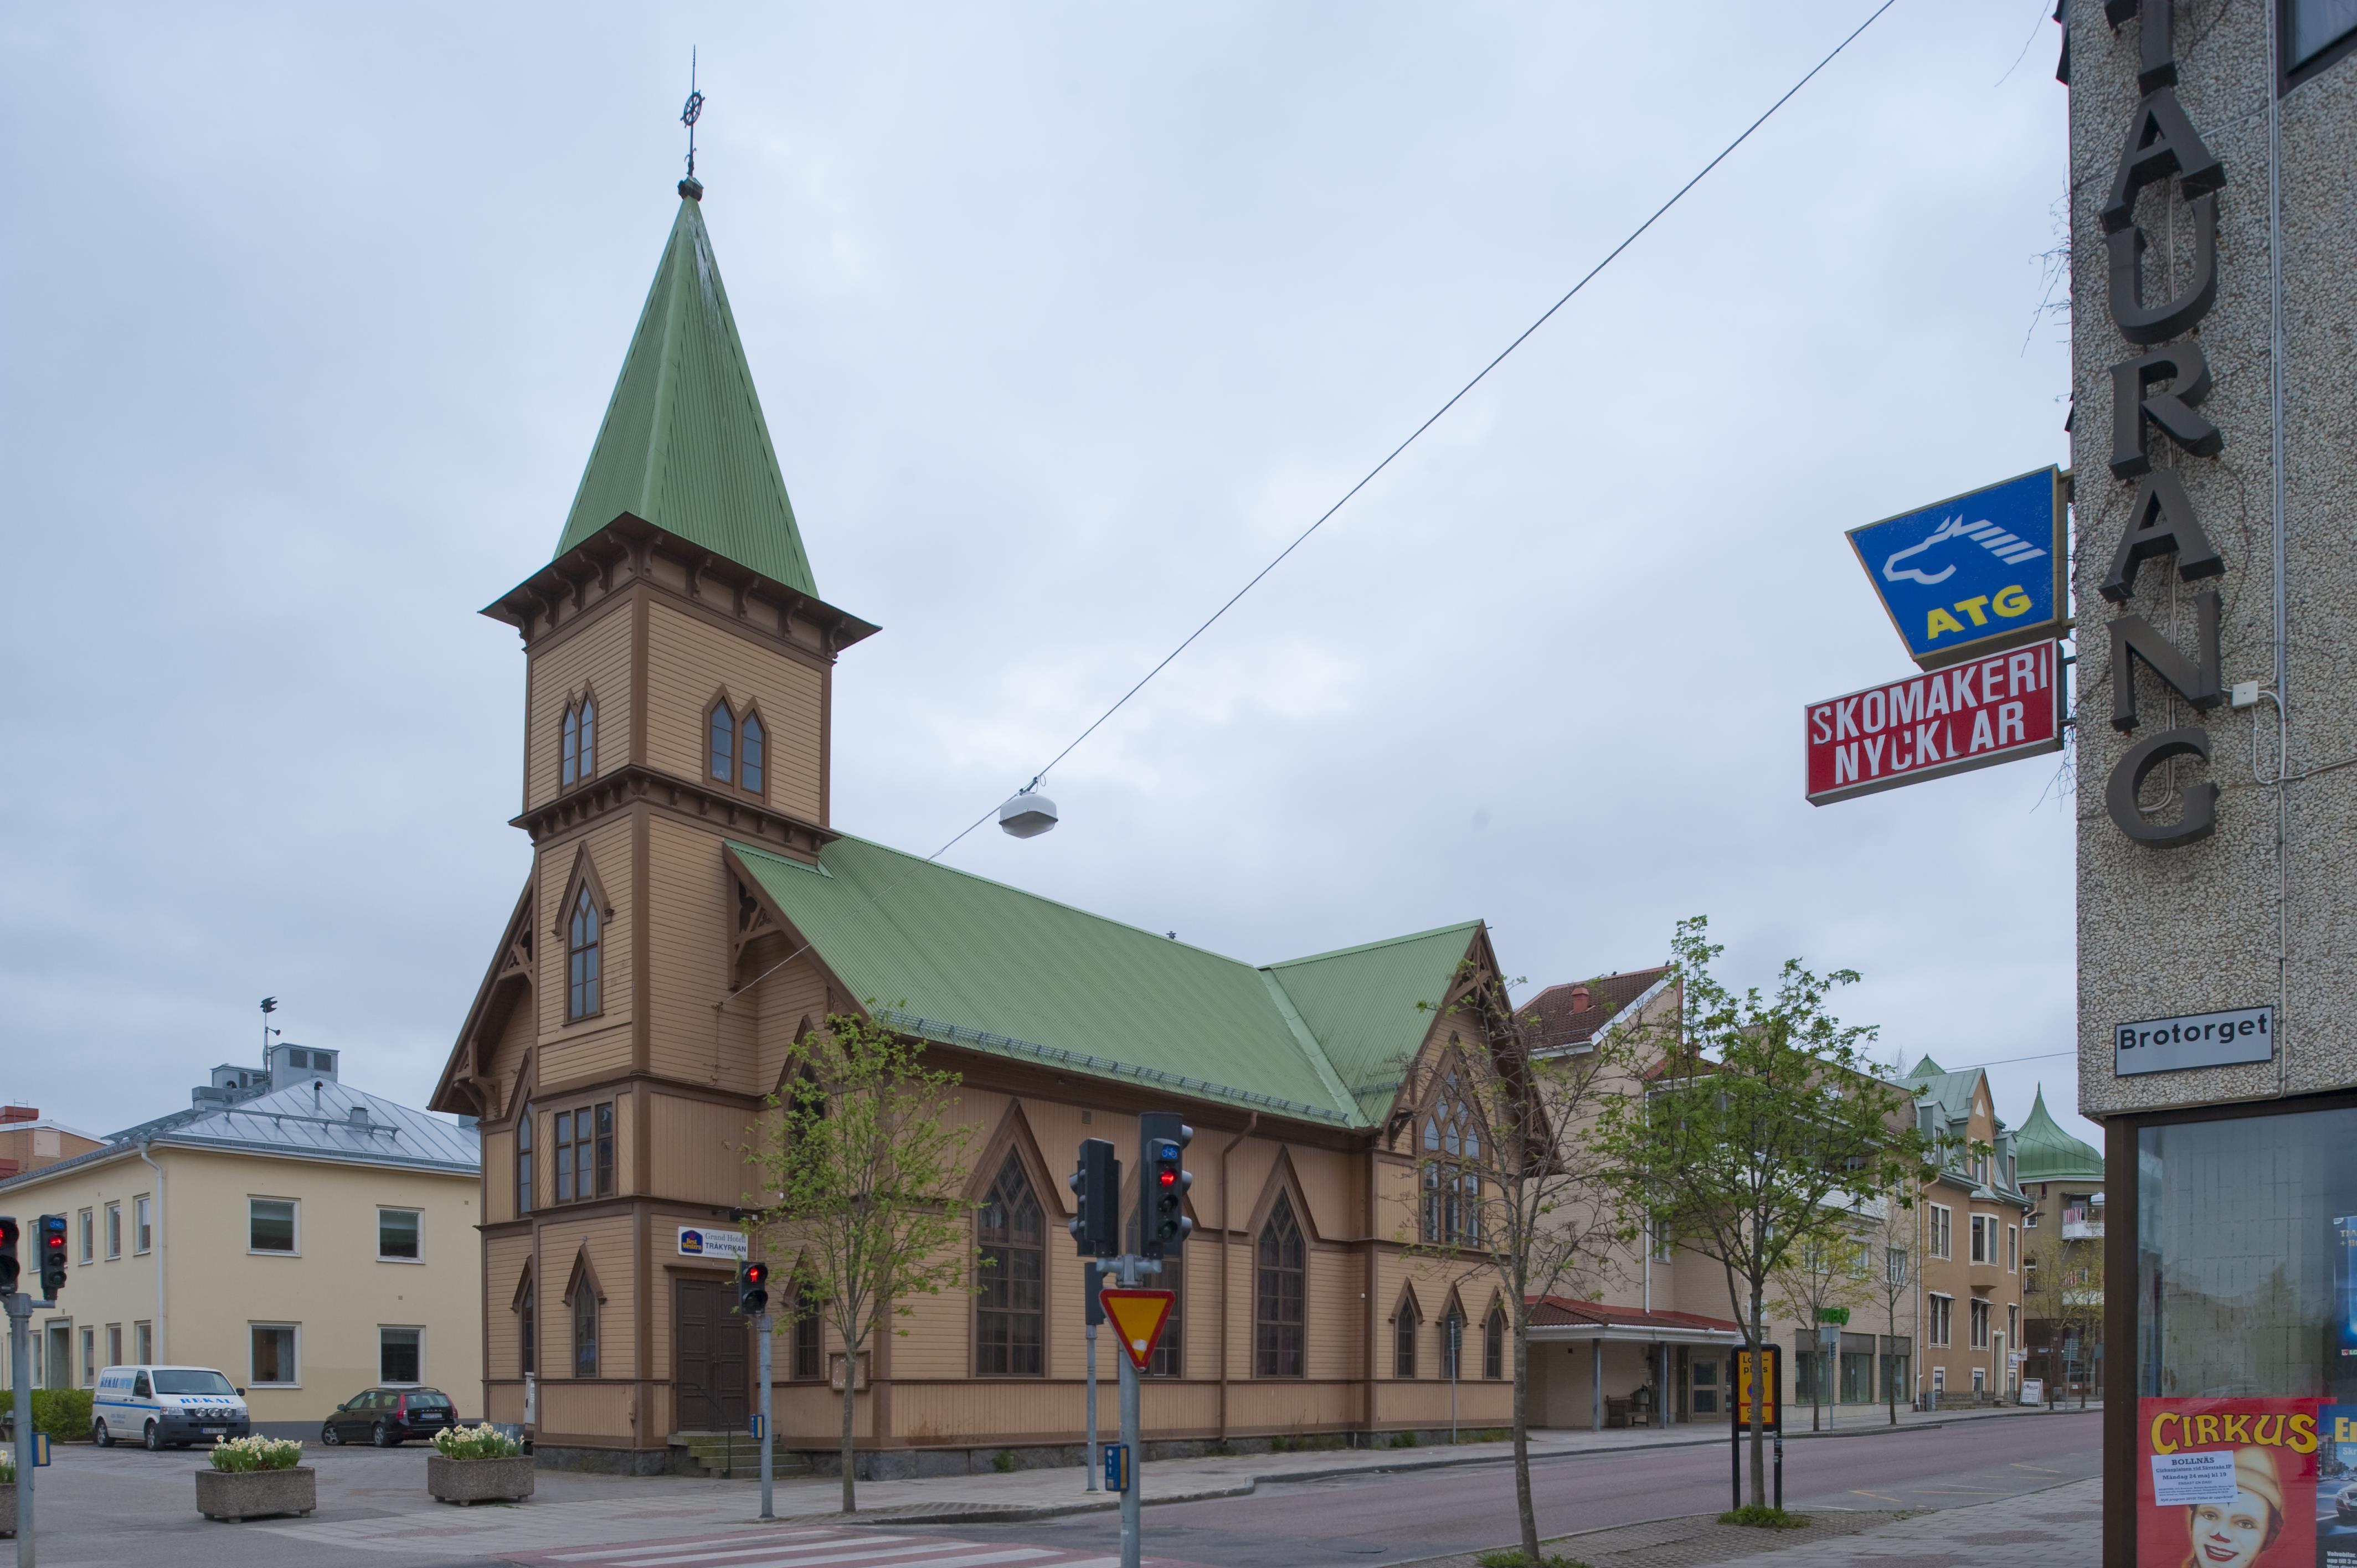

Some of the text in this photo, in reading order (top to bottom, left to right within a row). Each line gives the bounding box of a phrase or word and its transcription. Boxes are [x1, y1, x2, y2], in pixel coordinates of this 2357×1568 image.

[1927, 585, 2032, 640] ATG
[1812, 646, 2048, 745] SKOMAKERI
[1835, 700, 2026, 785] NYCKLAR
[2120, 1013, 2267, 1050] Brotorget
[704, 1232, 747, 1244] Grand Hotell
[1743, 1365, 1768, 1375] pls
[2150, 1411, 2318, 1456] CIRKUS
[2171, 1456, 2215, 1466] BOLLNÄS
